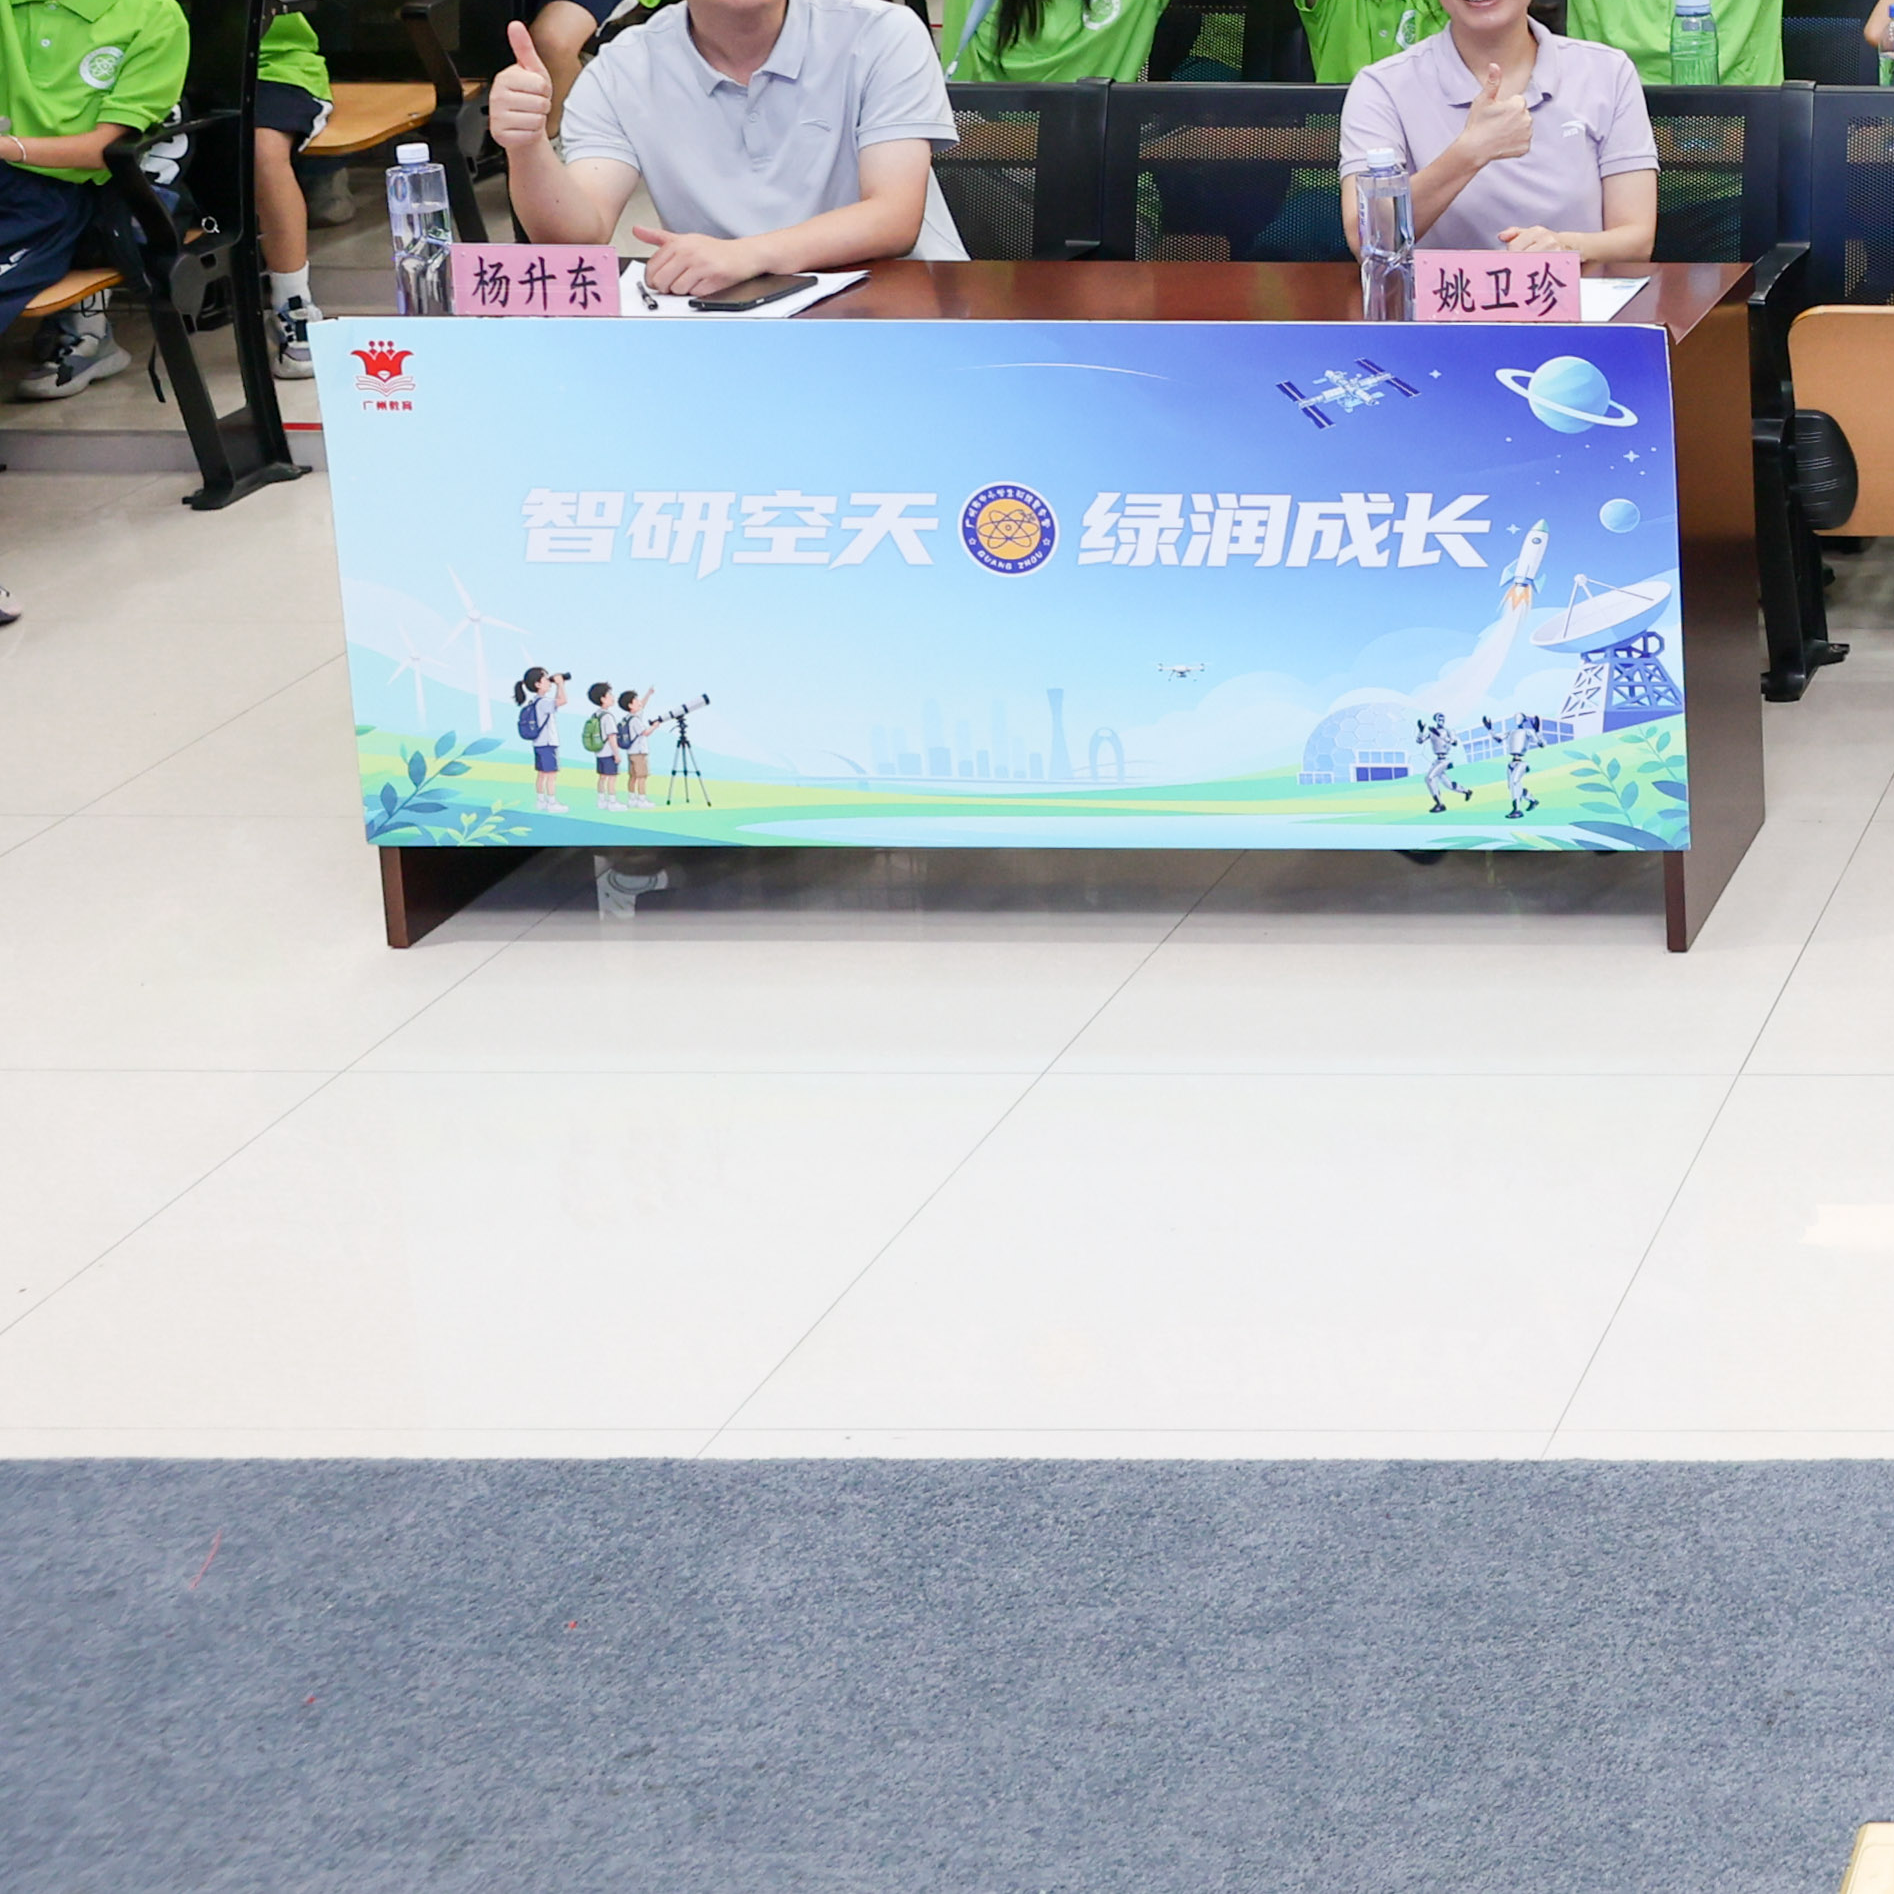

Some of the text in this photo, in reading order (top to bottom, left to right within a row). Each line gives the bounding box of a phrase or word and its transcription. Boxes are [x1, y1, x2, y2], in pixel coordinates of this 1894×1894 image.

[472, 255, 602, 311] 杨升东
[1432, 261, 1567, 317] 姚卫珍
[520, 488, 1493, 579] 智研空天 绿润成长
